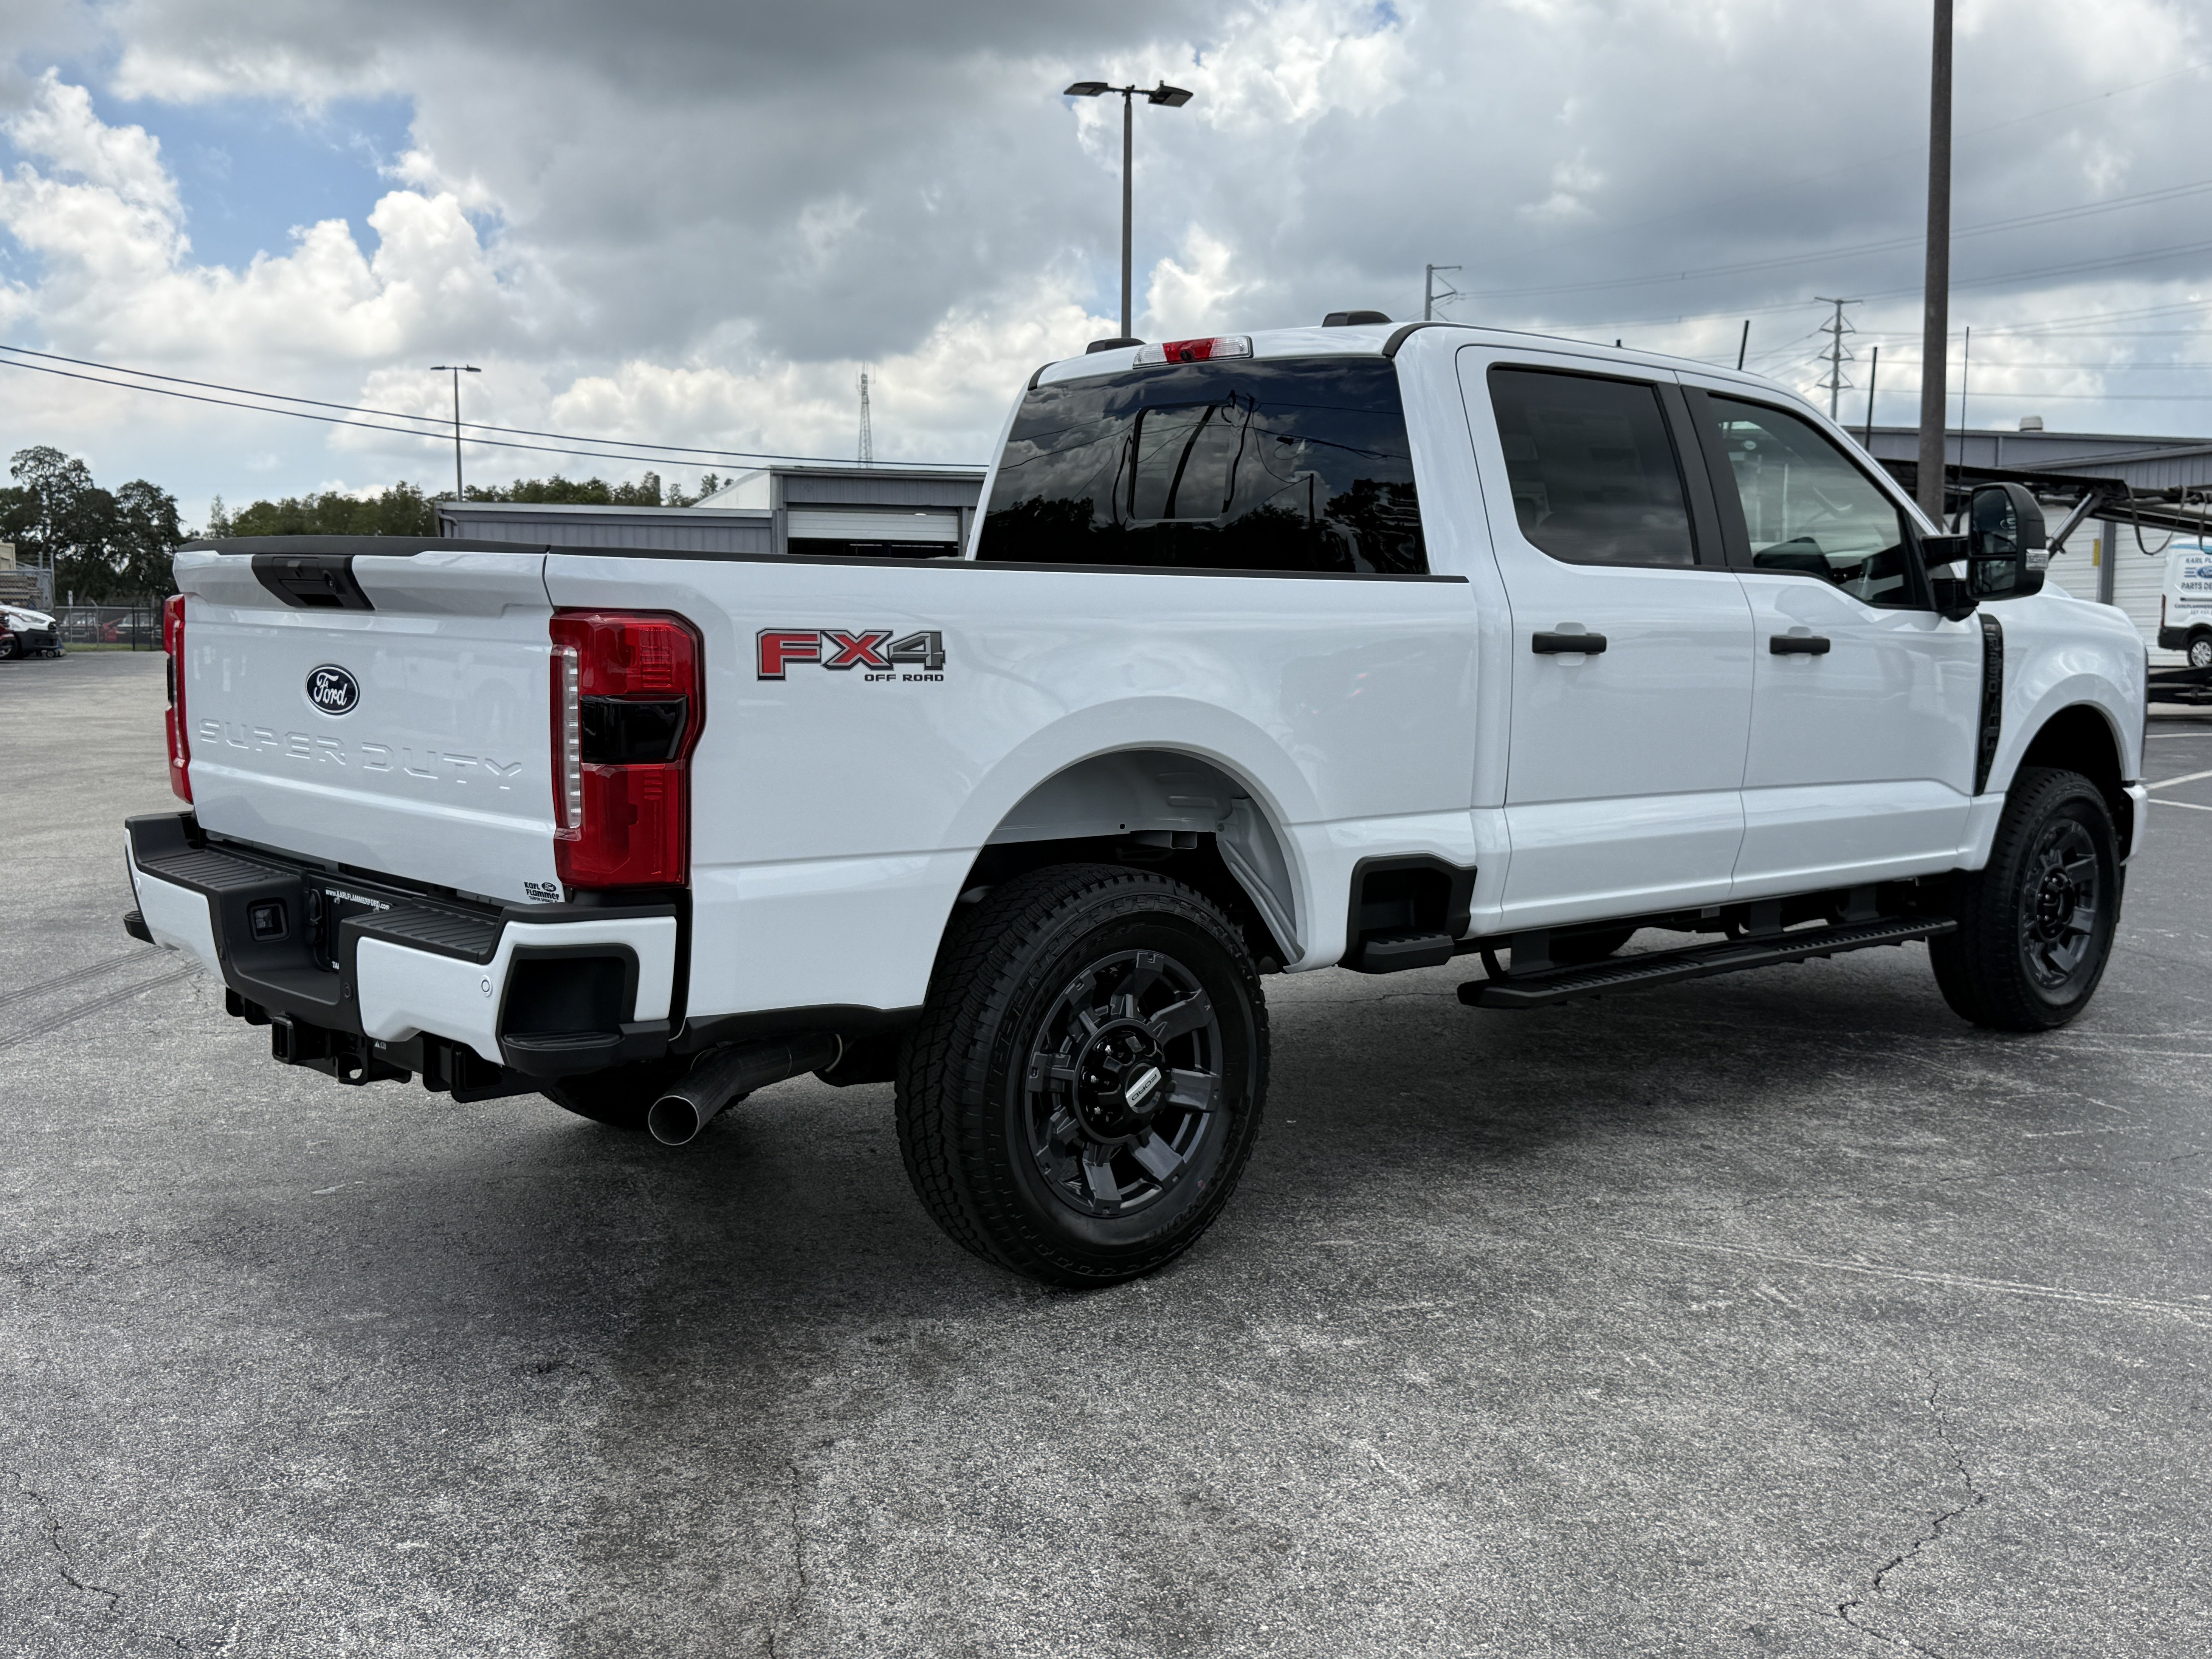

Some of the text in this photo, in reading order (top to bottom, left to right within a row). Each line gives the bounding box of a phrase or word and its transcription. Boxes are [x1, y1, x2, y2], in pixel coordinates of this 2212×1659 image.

[2181, 582, 2202, 590] PARTS
[756, 627, 946, 681] FX4
[314, 672, 348, 706] Ford
[864, 674, 944, 682] OFF ROAD
[200, 718, 522, 790] SUPER DUTY
[1132, 1074, 1157, 1101] FORD
